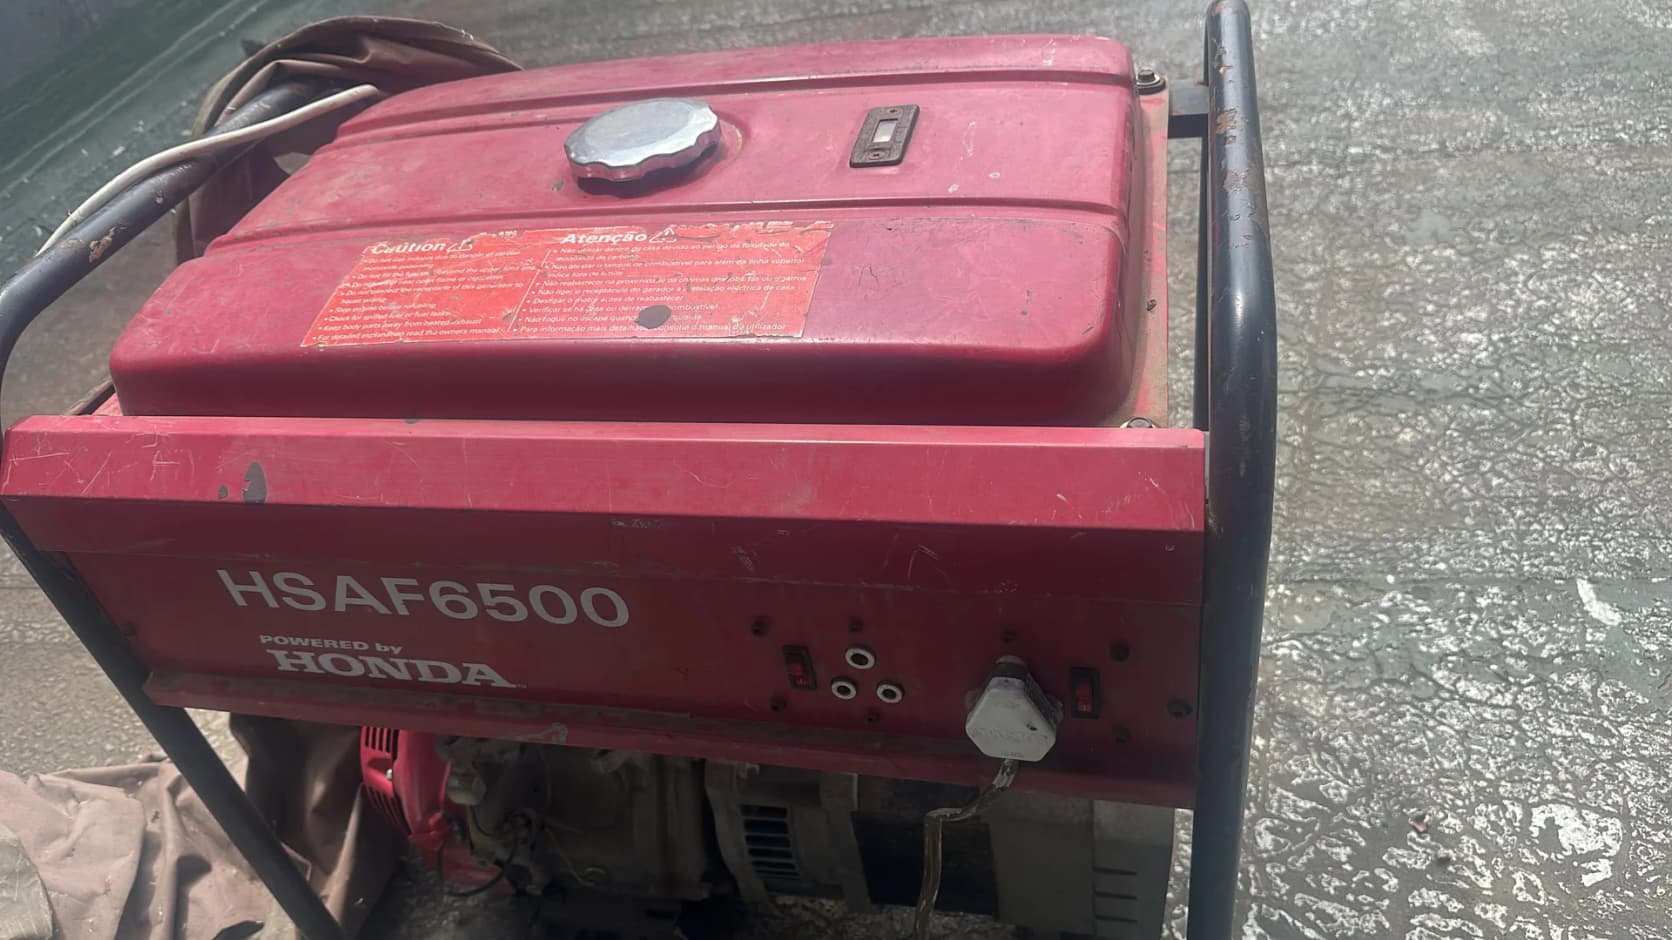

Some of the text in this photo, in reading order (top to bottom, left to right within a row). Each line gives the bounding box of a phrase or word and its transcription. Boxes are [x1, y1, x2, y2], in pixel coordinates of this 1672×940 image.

[370, 242, 446, 254] Caution
[560, 231, 647, 245] Atenção
[216, 569, 629, 628] HSAF6500
[259, 634, 404, 655] POWERED by
[266, 648, 517, 689] HONDA
